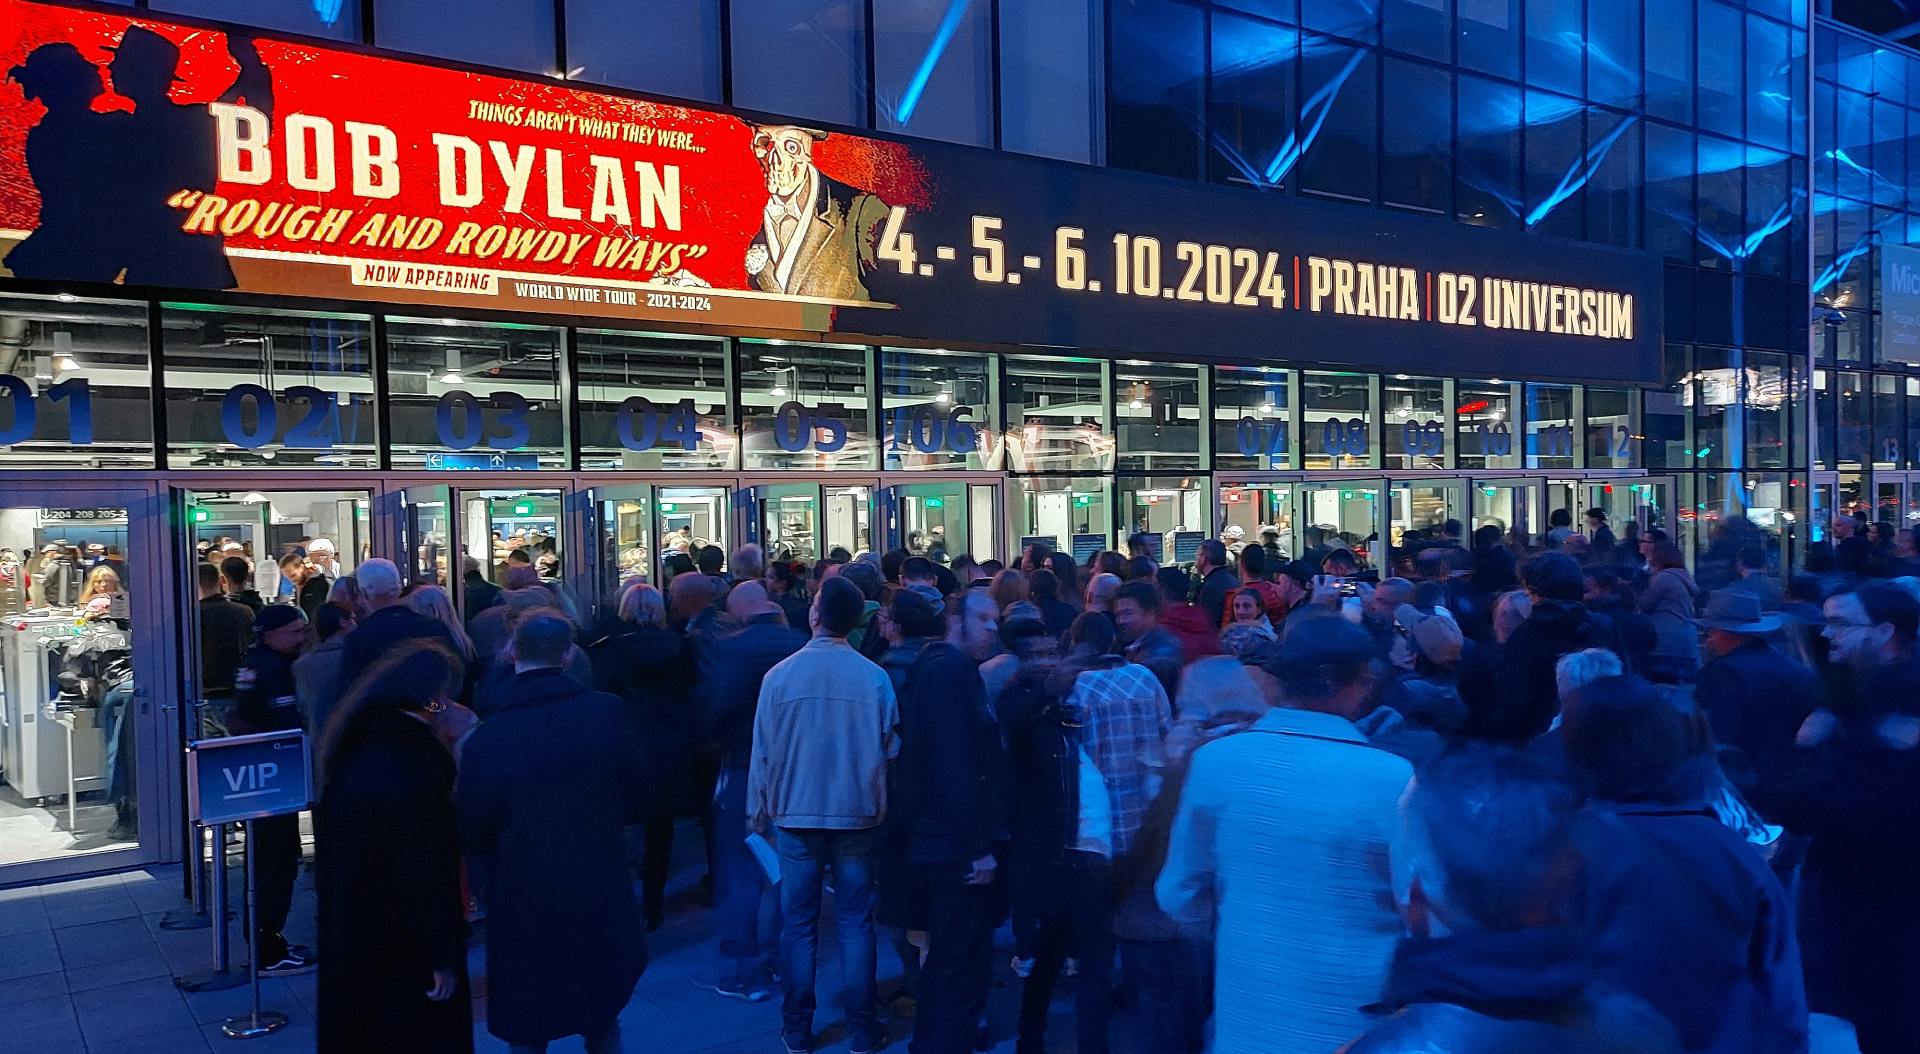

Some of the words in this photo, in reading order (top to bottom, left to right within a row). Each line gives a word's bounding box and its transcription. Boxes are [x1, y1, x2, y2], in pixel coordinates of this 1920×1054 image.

[468, 99, 523, 125] THINGS
[524, 108, 578, 134] AREN'T
[578, 116, 620, 140] WHAT
[622, 122, 655, 146] THEY
[209, 102, 401, 200] BOB
[432, 132, 682, 231] DYLAN
[349, 212, 444, 251] AND
[445, 220, 593, 265] ROWDY
[363, 263, 400, 283] NOW
[405, 268, 489, 290] APPEARING
[514, 281, 565, 301] WORLD
[566, 285, 601, 303] WIDE
[603, 289, 637, 306] TOUR
[647, 293, 712, 312] 2021-2024
[1055, 226, 1101, 291] 6.
[1112, 232, 1287, 309] 10.2024
[1307, 256, 1421, 322] PRAHA
[1482, 276, 1634, 341] UNIVERSUM
[222, 383, 333, 449] 02
[435, 389, 532, 450] 03
[616, 396, 703, 452] 04
[774, 401, 848, 454] 05
[910, 404, 979, 455] 06
[1236, 415, 1283, 457] 07
[1323, 417, 1367, 457] 08
[1402, 419, 1442, 457] 09
[1476, 422, 1510, 456] 10
[1537, 425, 1573, 457] 11
[1604, 425, 1631, 458] 12
[1882, 437, 1899, 462] 13
[52, 510, 72, 519] 204
[75, 510, 95, 519] 208
[222, 762, 279, 792] VIP
